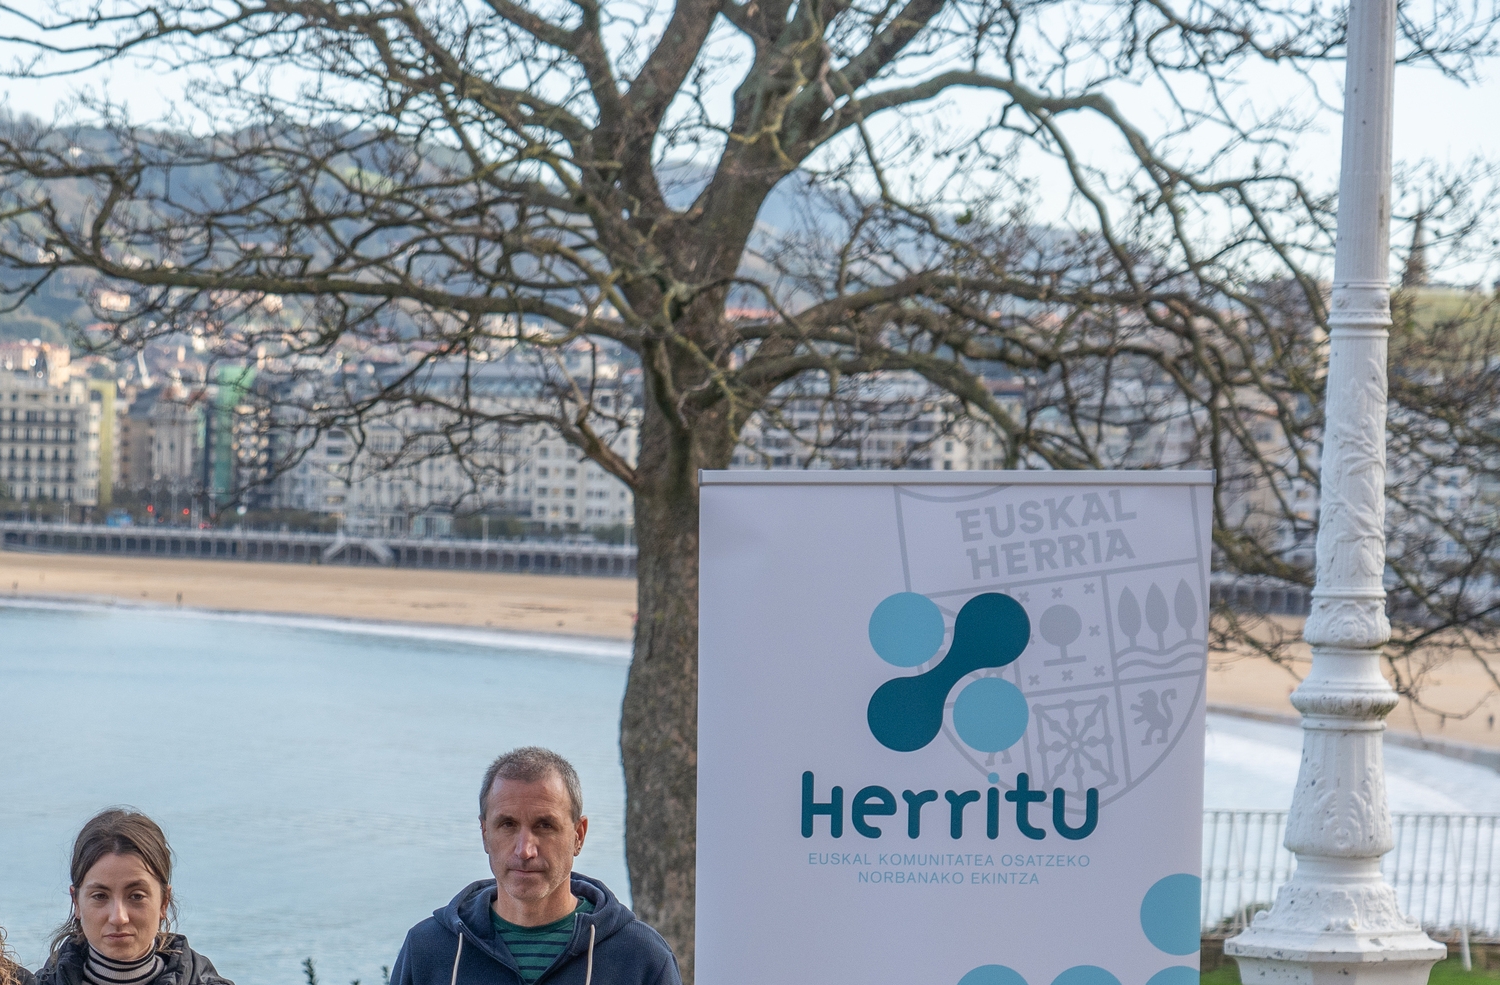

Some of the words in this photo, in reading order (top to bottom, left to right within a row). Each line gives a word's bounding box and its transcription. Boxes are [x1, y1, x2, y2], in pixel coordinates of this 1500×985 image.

[955, 489, 1137, 543] EUSKAL
[966, 528, 1136, 581] HERRIA
[808, 853, 872, 866] EUSKAL
[879, 853, 994, 867] KOMUNITATEA
[1001, 854, 1091, 868] OSATZEKO
[858, 871, 964, 884] NORBANAKO
[971, 872, 1039, 885] EKINTZA
